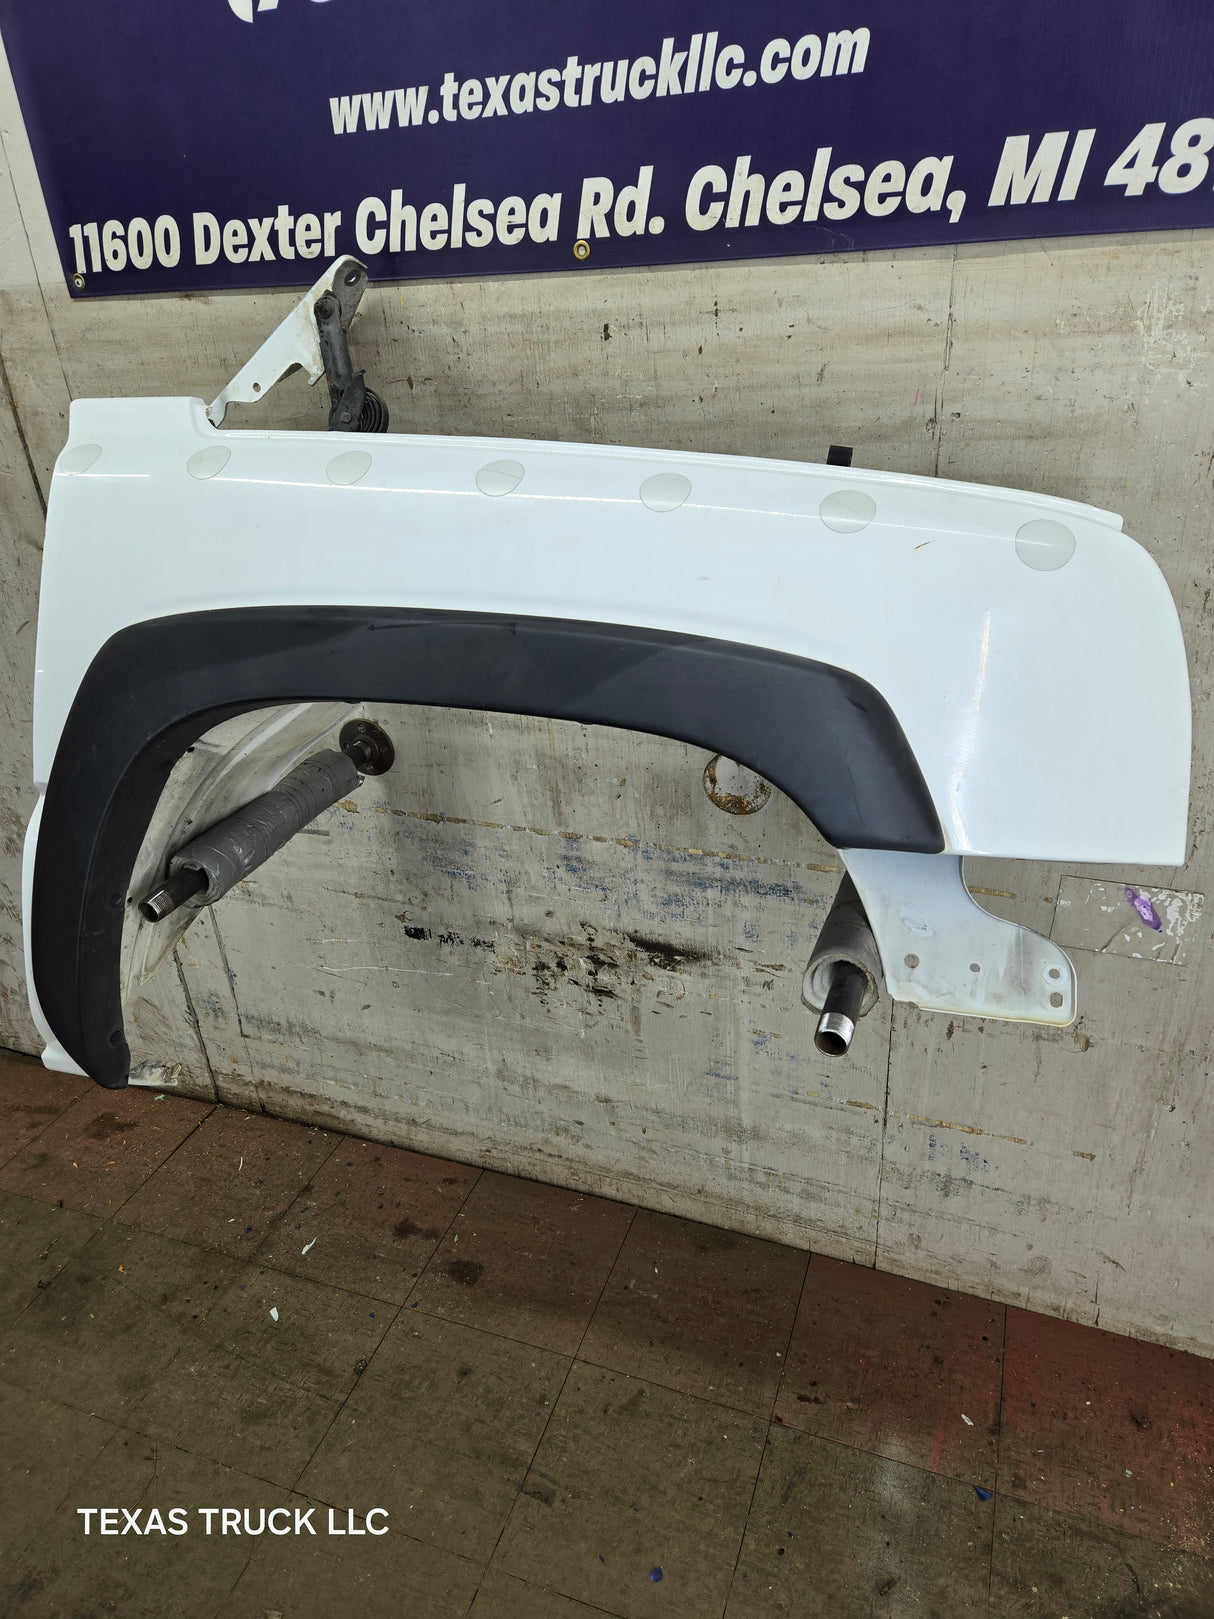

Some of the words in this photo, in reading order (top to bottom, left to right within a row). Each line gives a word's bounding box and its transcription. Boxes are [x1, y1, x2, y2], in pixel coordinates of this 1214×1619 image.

[329, 27, 871, 135] www.texastruckllc.com
[69, 212, 180, 274] 11600
[193, 205, 342, 266] Dexter
[356, 183, 562, 255] Chelsea
[577, 165, 665, 240] Rd.
[686, 147, 966, 231] Chelsea,
[988, 129, 1097, 207] MI
[1104, 117, 1214, 197] 48
